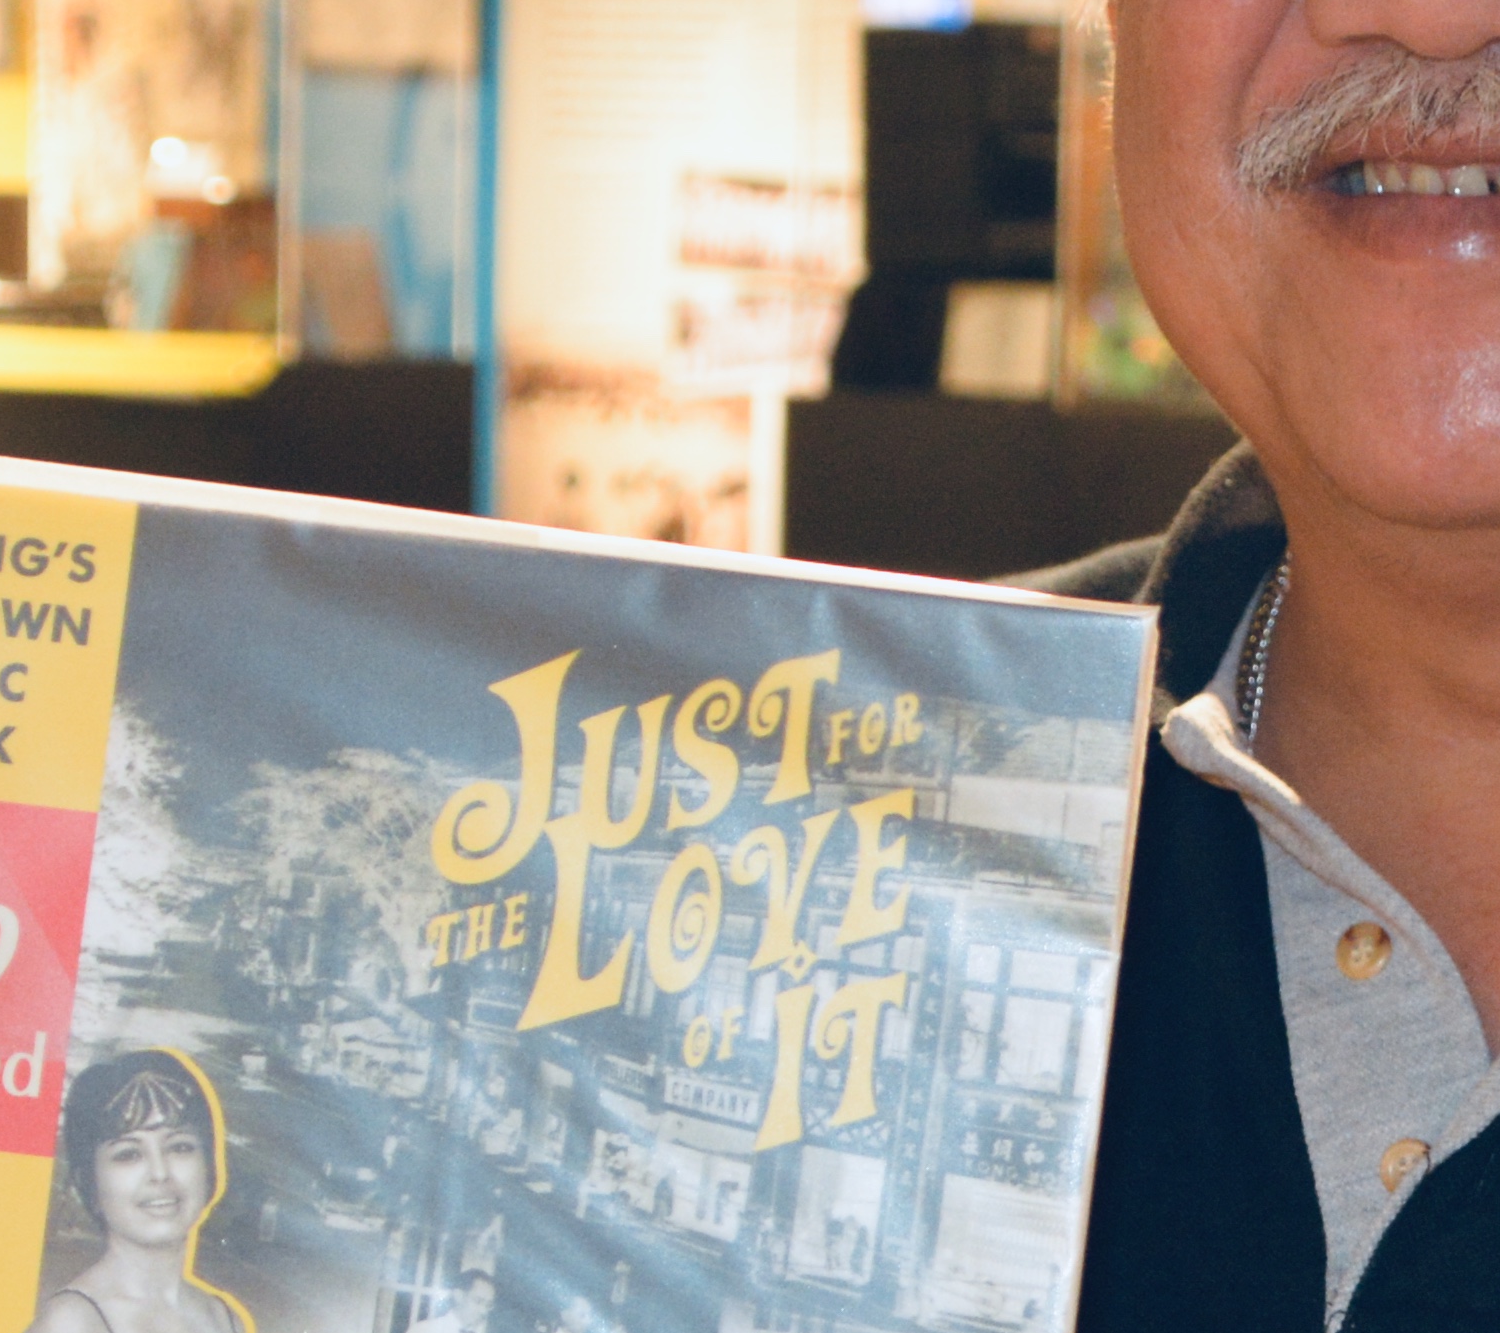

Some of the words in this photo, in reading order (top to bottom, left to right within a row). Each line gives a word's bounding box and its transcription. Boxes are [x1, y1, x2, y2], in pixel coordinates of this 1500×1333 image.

[825, 692, 923, 765] FOR
[426, 893, 529, 968] THE
[516, 788, 914, 1032] LOVE
[671, 1081, 751, 1117] COMPANY
[683, 1006, 744, 1068] OF
[753, 971, 907, 1153] IT
